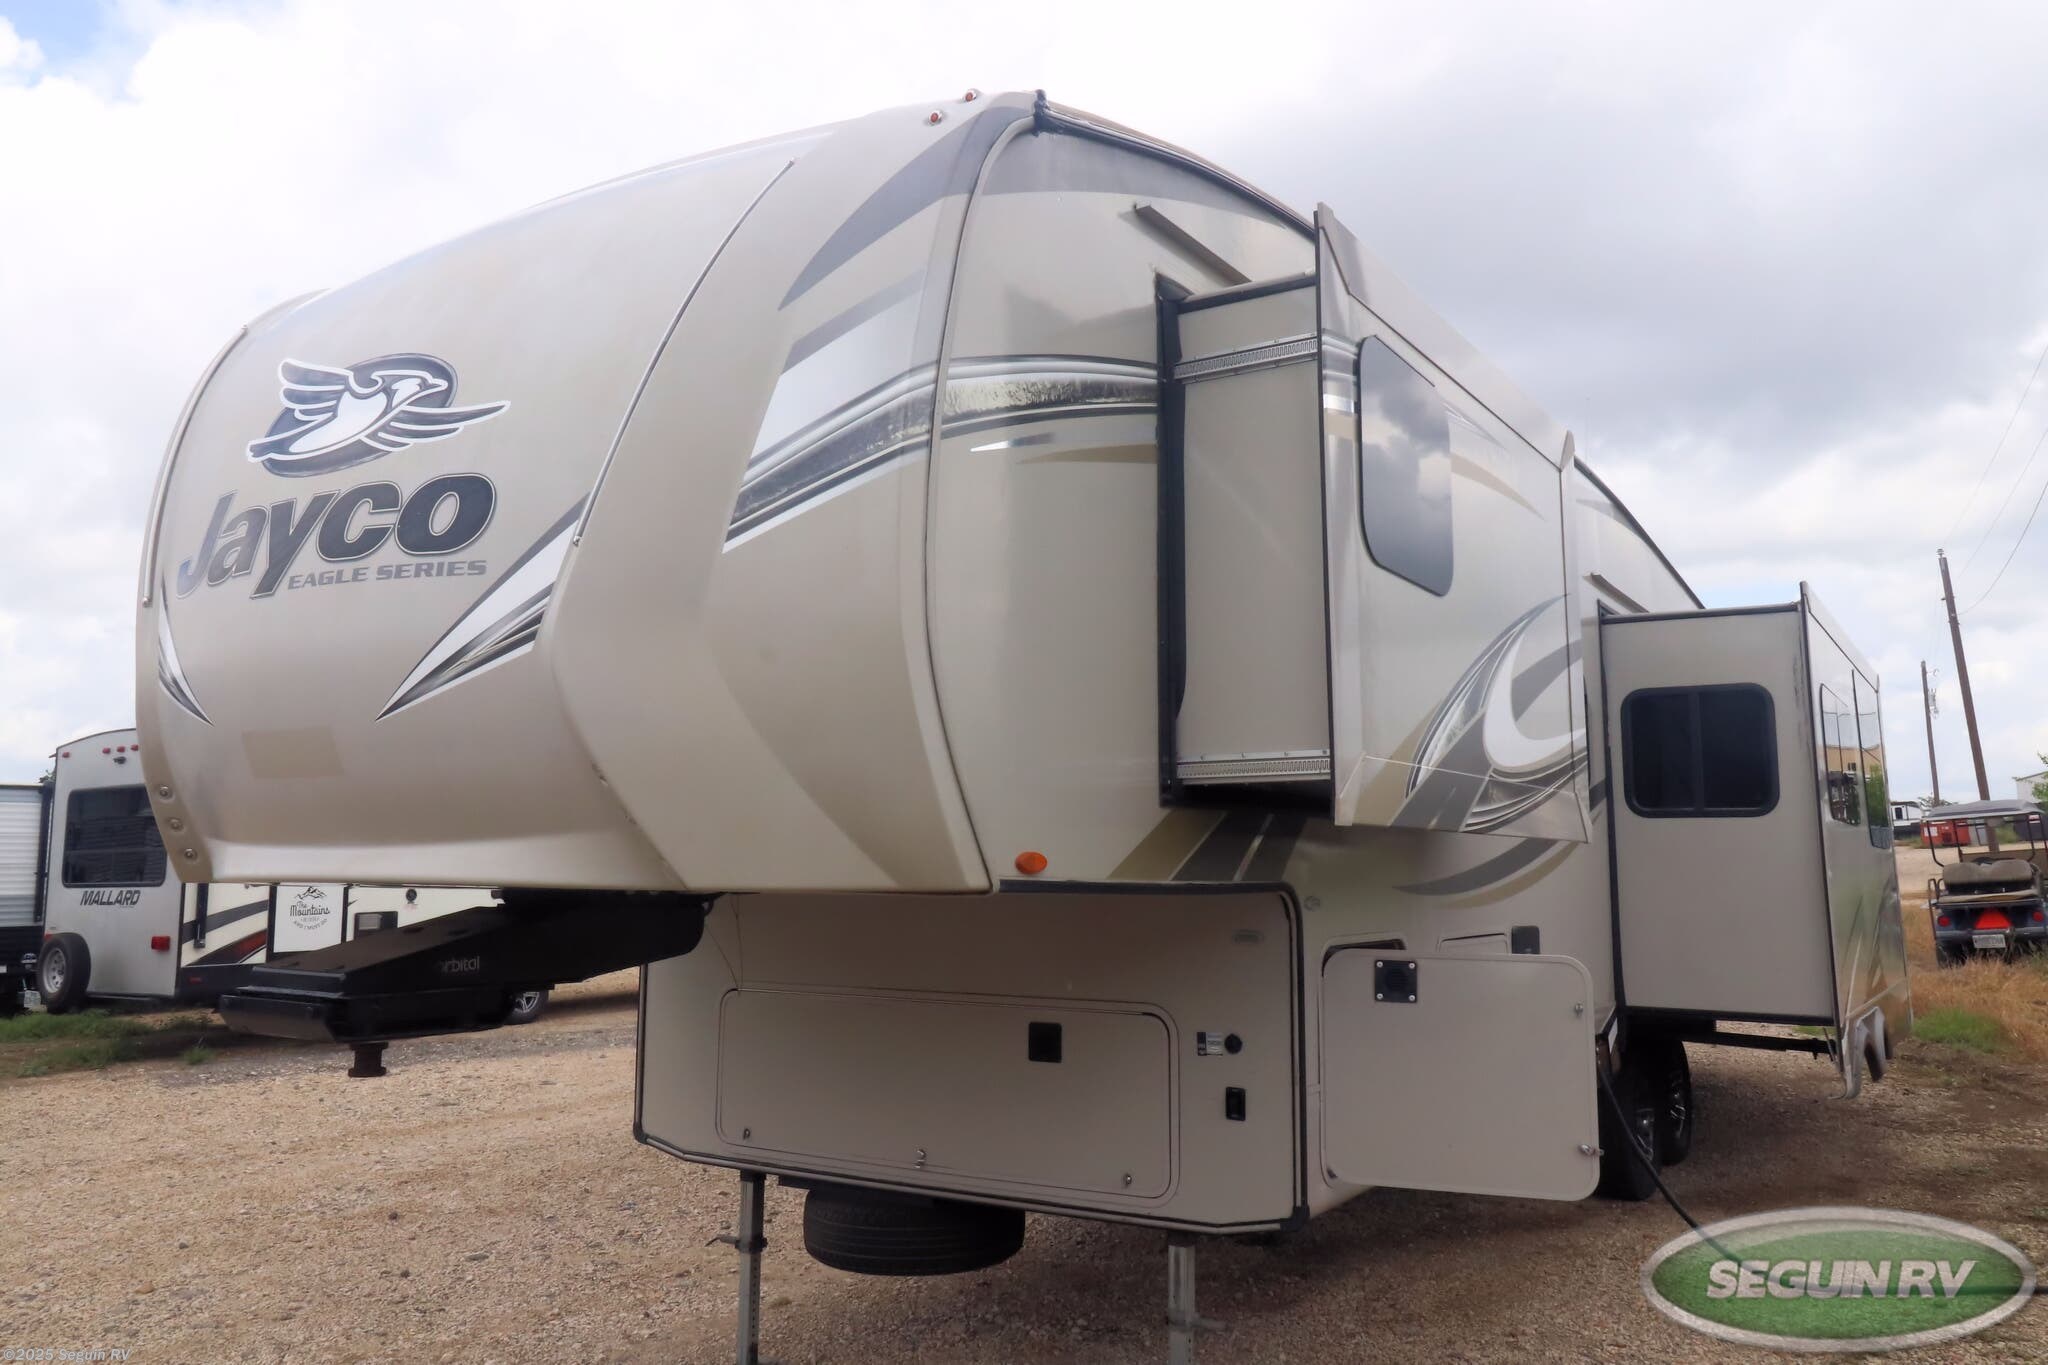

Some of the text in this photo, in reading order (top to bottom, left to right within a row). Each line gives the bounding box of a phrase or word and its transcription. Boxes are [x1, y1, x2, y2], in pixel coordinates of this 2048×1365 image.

[176, 473, 496, 600] Jayco
[287, 559, 487, 590] EAGLE SERIES
[80, 889, 141, 906] MALLARD
[289, 904, 331, 917] Mountains
